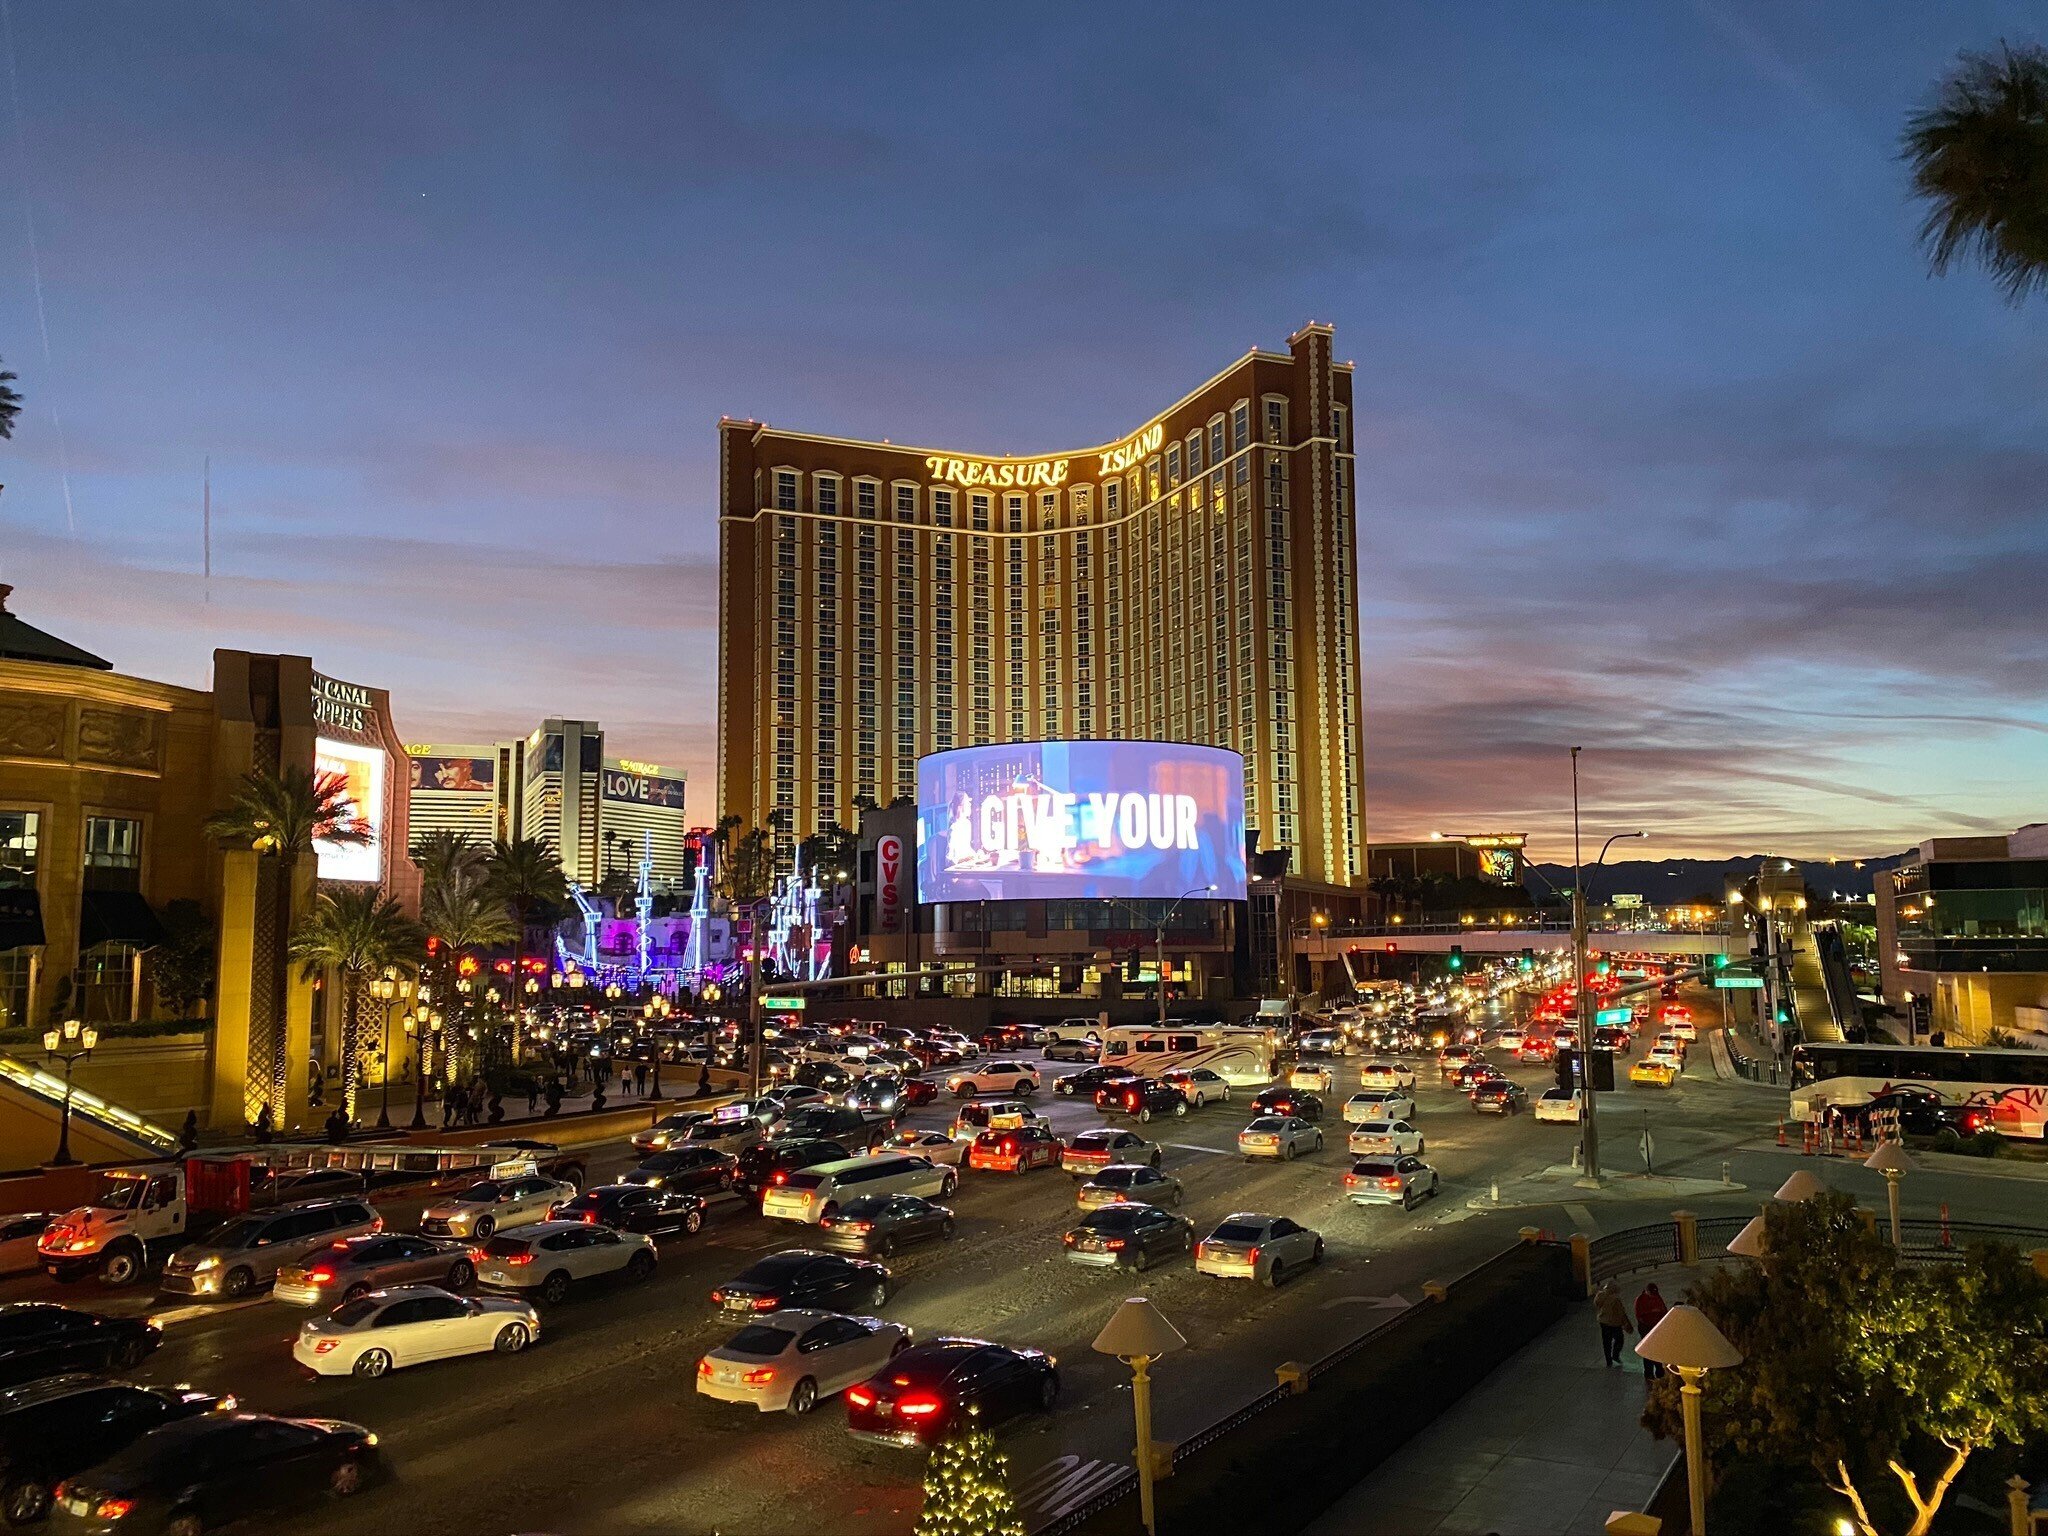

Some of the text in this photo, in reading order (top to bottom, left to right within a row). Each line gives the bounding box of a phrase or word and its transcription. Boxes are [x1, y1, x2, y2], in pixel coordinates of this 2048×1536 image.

[926, 423, 1164, 487] TREASURE ISLAND
[312, 696, 364, 732] OPPES
[324, 680, 372, 706] CANAL
[403, 743, 431, 755] AGE
[607, 774, 649, 800] LOVE
[980, 792, 1200, 853] GIVE YOUR
[882, 840, 899, 905] CVS
[1010, 1454, 1131, 1518] ONL
